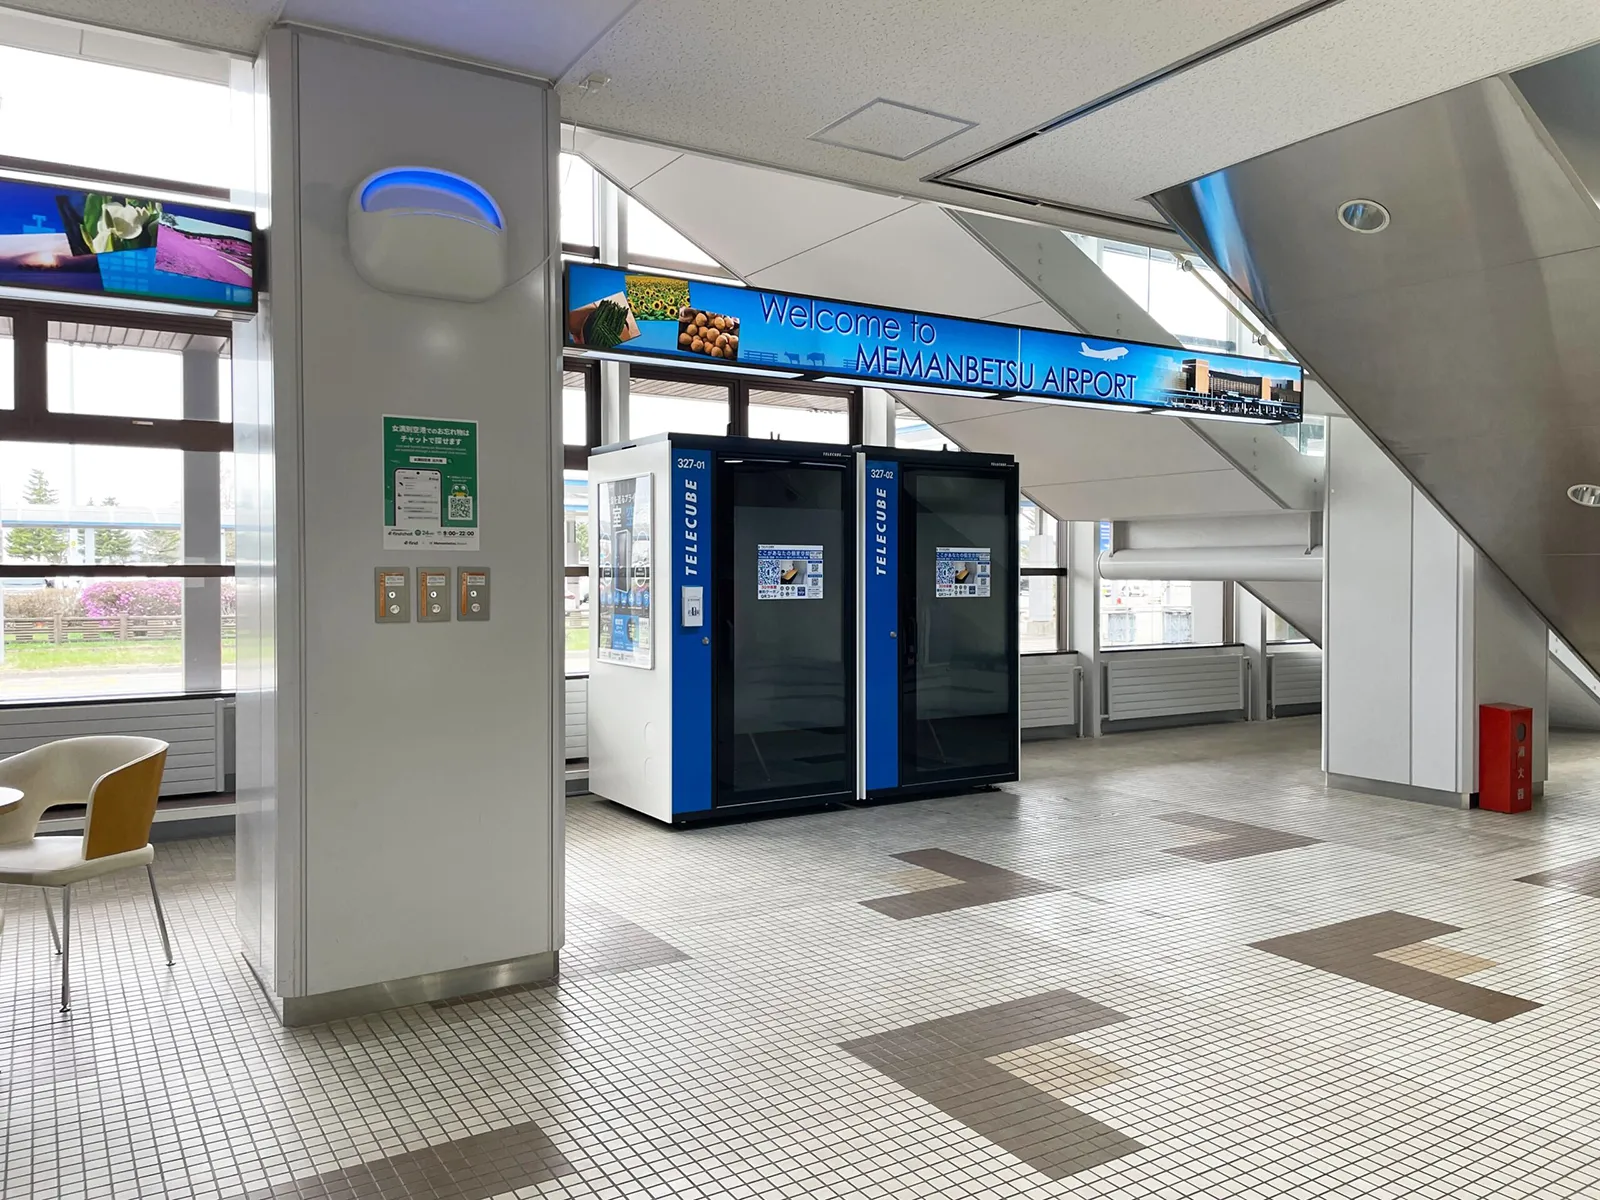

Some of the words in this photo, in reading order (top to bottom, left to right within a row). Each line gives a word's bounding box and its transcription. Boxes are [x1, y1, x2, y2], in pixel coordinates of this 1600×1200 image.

[760, 292, 900, 341] Welcome
[911, 314, 936, 344] to
[855, 343, 1034, 389] MEMANBETSU
[1042, 366, 1137, 400] AIRPORT
[677, 458, 705, 469] 327-01
[871, 469, 893, 479] 327-02
[685, 479, 698, 575] TELECUBE
[876, 487, 887, 575] TELECUBE
